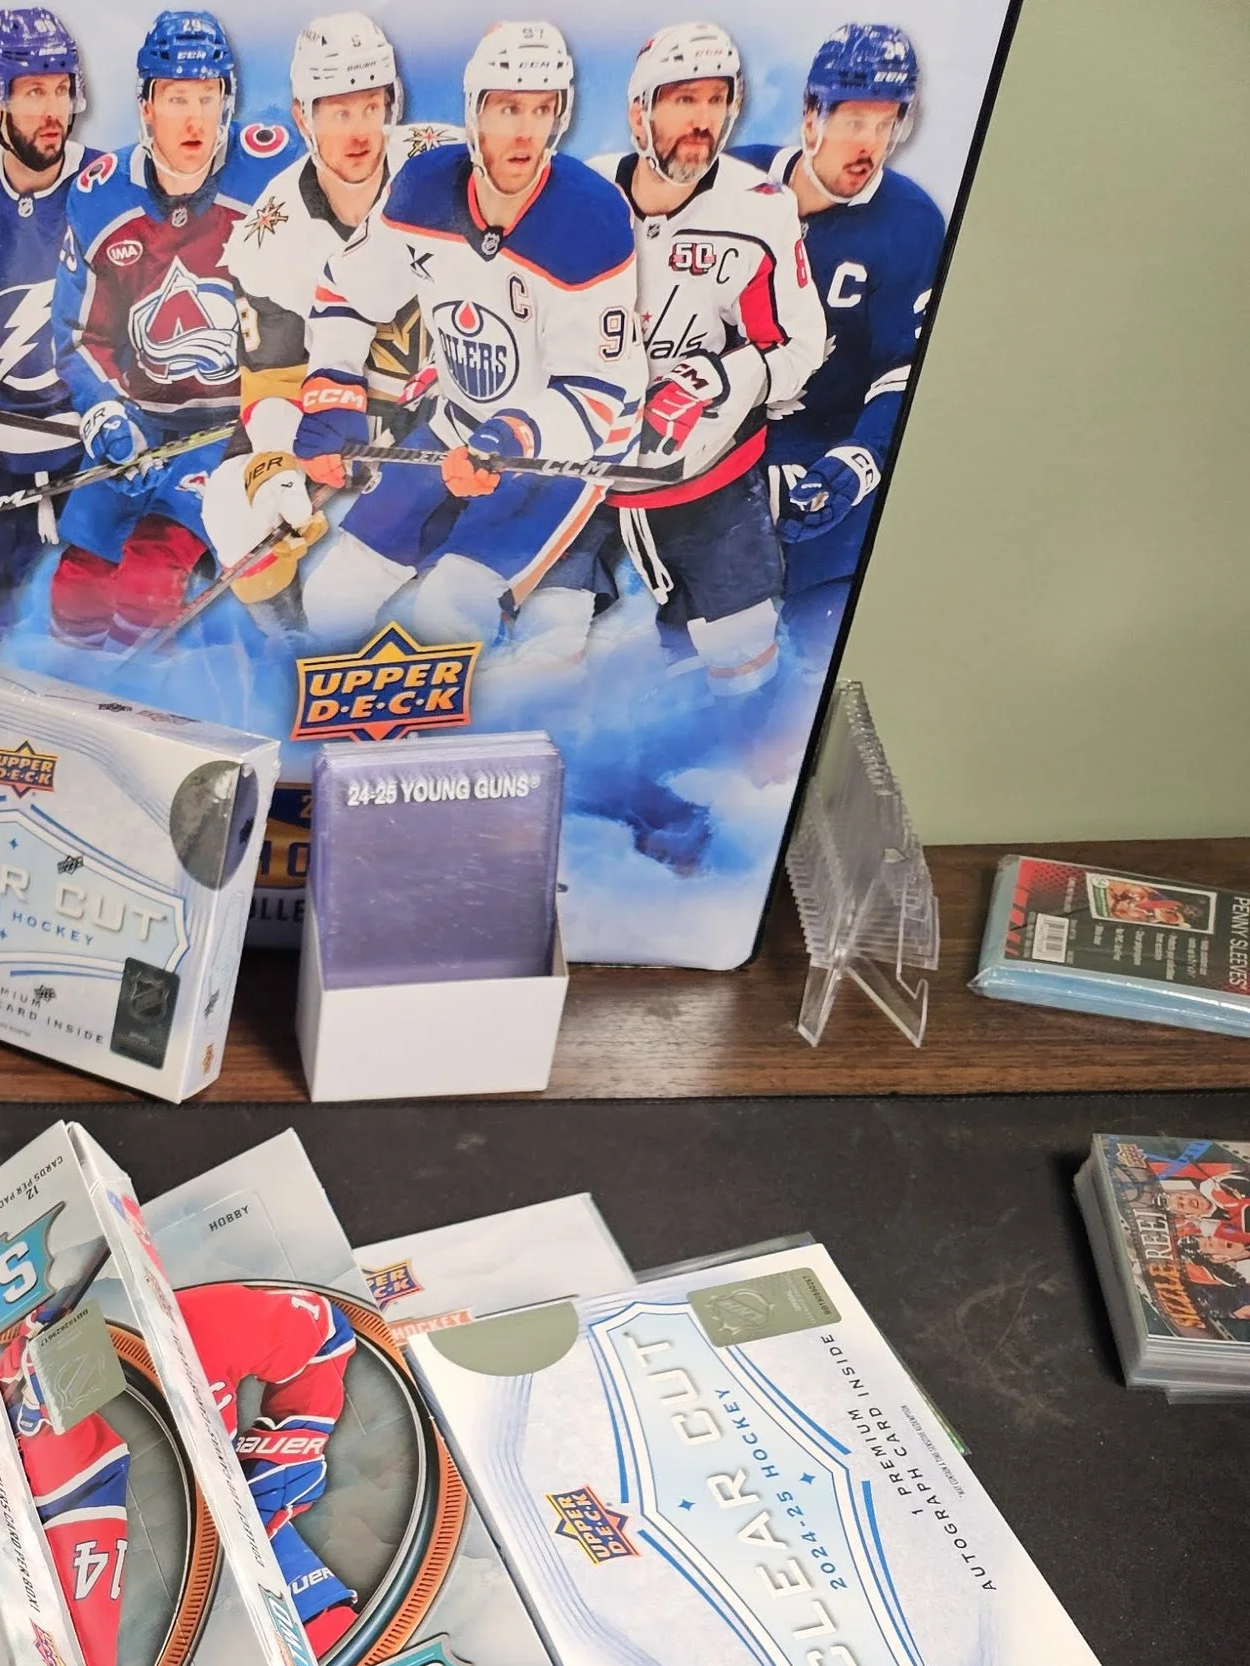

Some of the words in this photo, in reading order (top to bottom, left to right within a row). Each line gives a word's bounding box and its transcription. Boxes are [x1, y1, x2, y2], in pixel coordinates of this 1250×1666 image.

[826, 262, 868, 308] C
[308, 661, 465, 697] UPPER
[347, 780, 398, 806] 24-25
[401, 776, 472, 802] YOUNG
[12, 911, 95, 947] HOCKEY
[54, 884, 166, 942] CUT
[46, 1018, 105, 1045] INSIDE
[16, 1180, 33, 1195] PER
[34, 1155, 63, 1180] CARDS
[209, 1205, 250, 1232] HOBBY
[625, 1331, 724, 1446] CUT
[821, 1333, 870, 1397] INSIDE
[714, 1389, 779, 1479] HOCKEY
[848, 1408, 913, 1497] PREMIUM
[869, 1406, 908, 1457] CARD
[558, 1494, 606, 1560] UPPER
[777, 1490, 849, 1591] 2024-25
[907, 1467, 998, 1592] AUTOGRAPH
